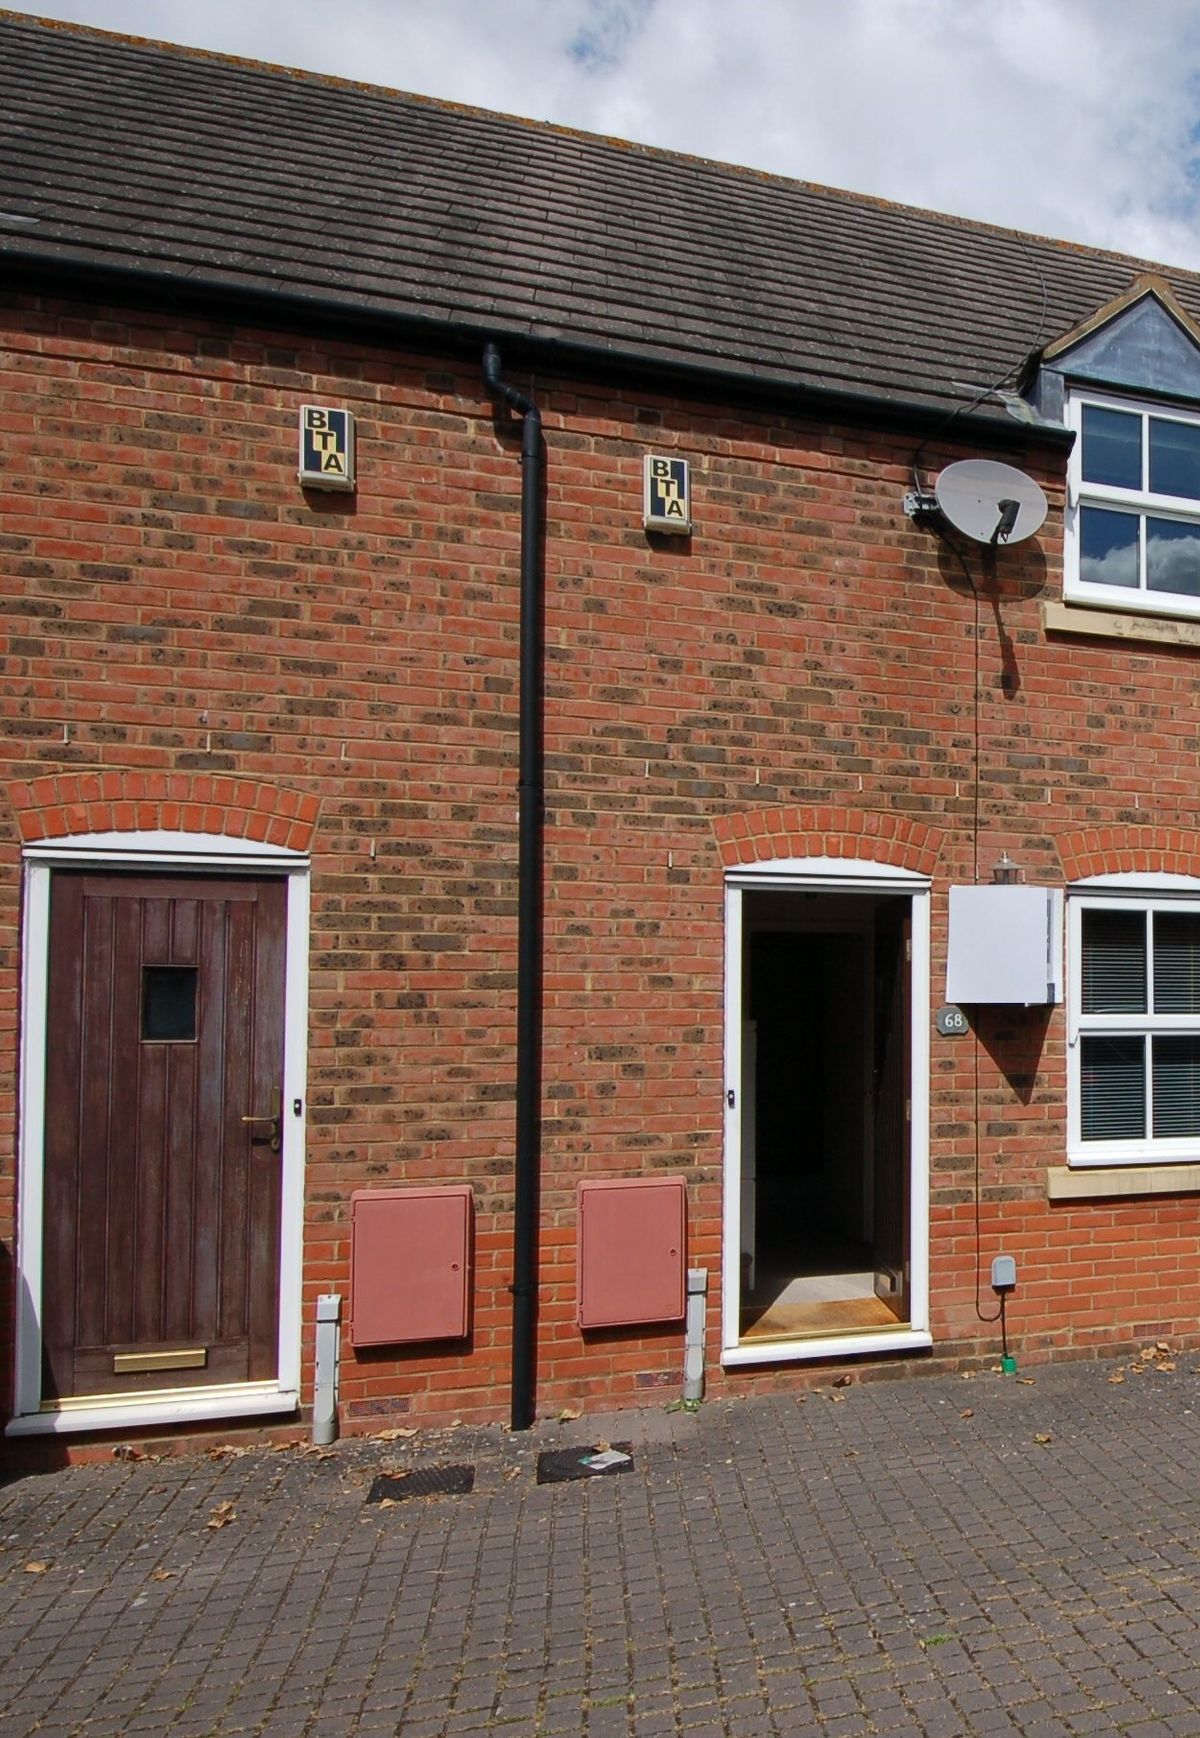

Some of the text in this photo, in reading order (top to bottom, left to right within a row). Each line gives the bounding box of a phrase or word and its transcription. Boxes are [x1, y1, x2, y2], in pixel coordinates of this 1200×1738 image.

[307, 408, 344, 473] BTA
[653, 459, 683, 517] BTA
[944, 1013, 962, 1027] 68
